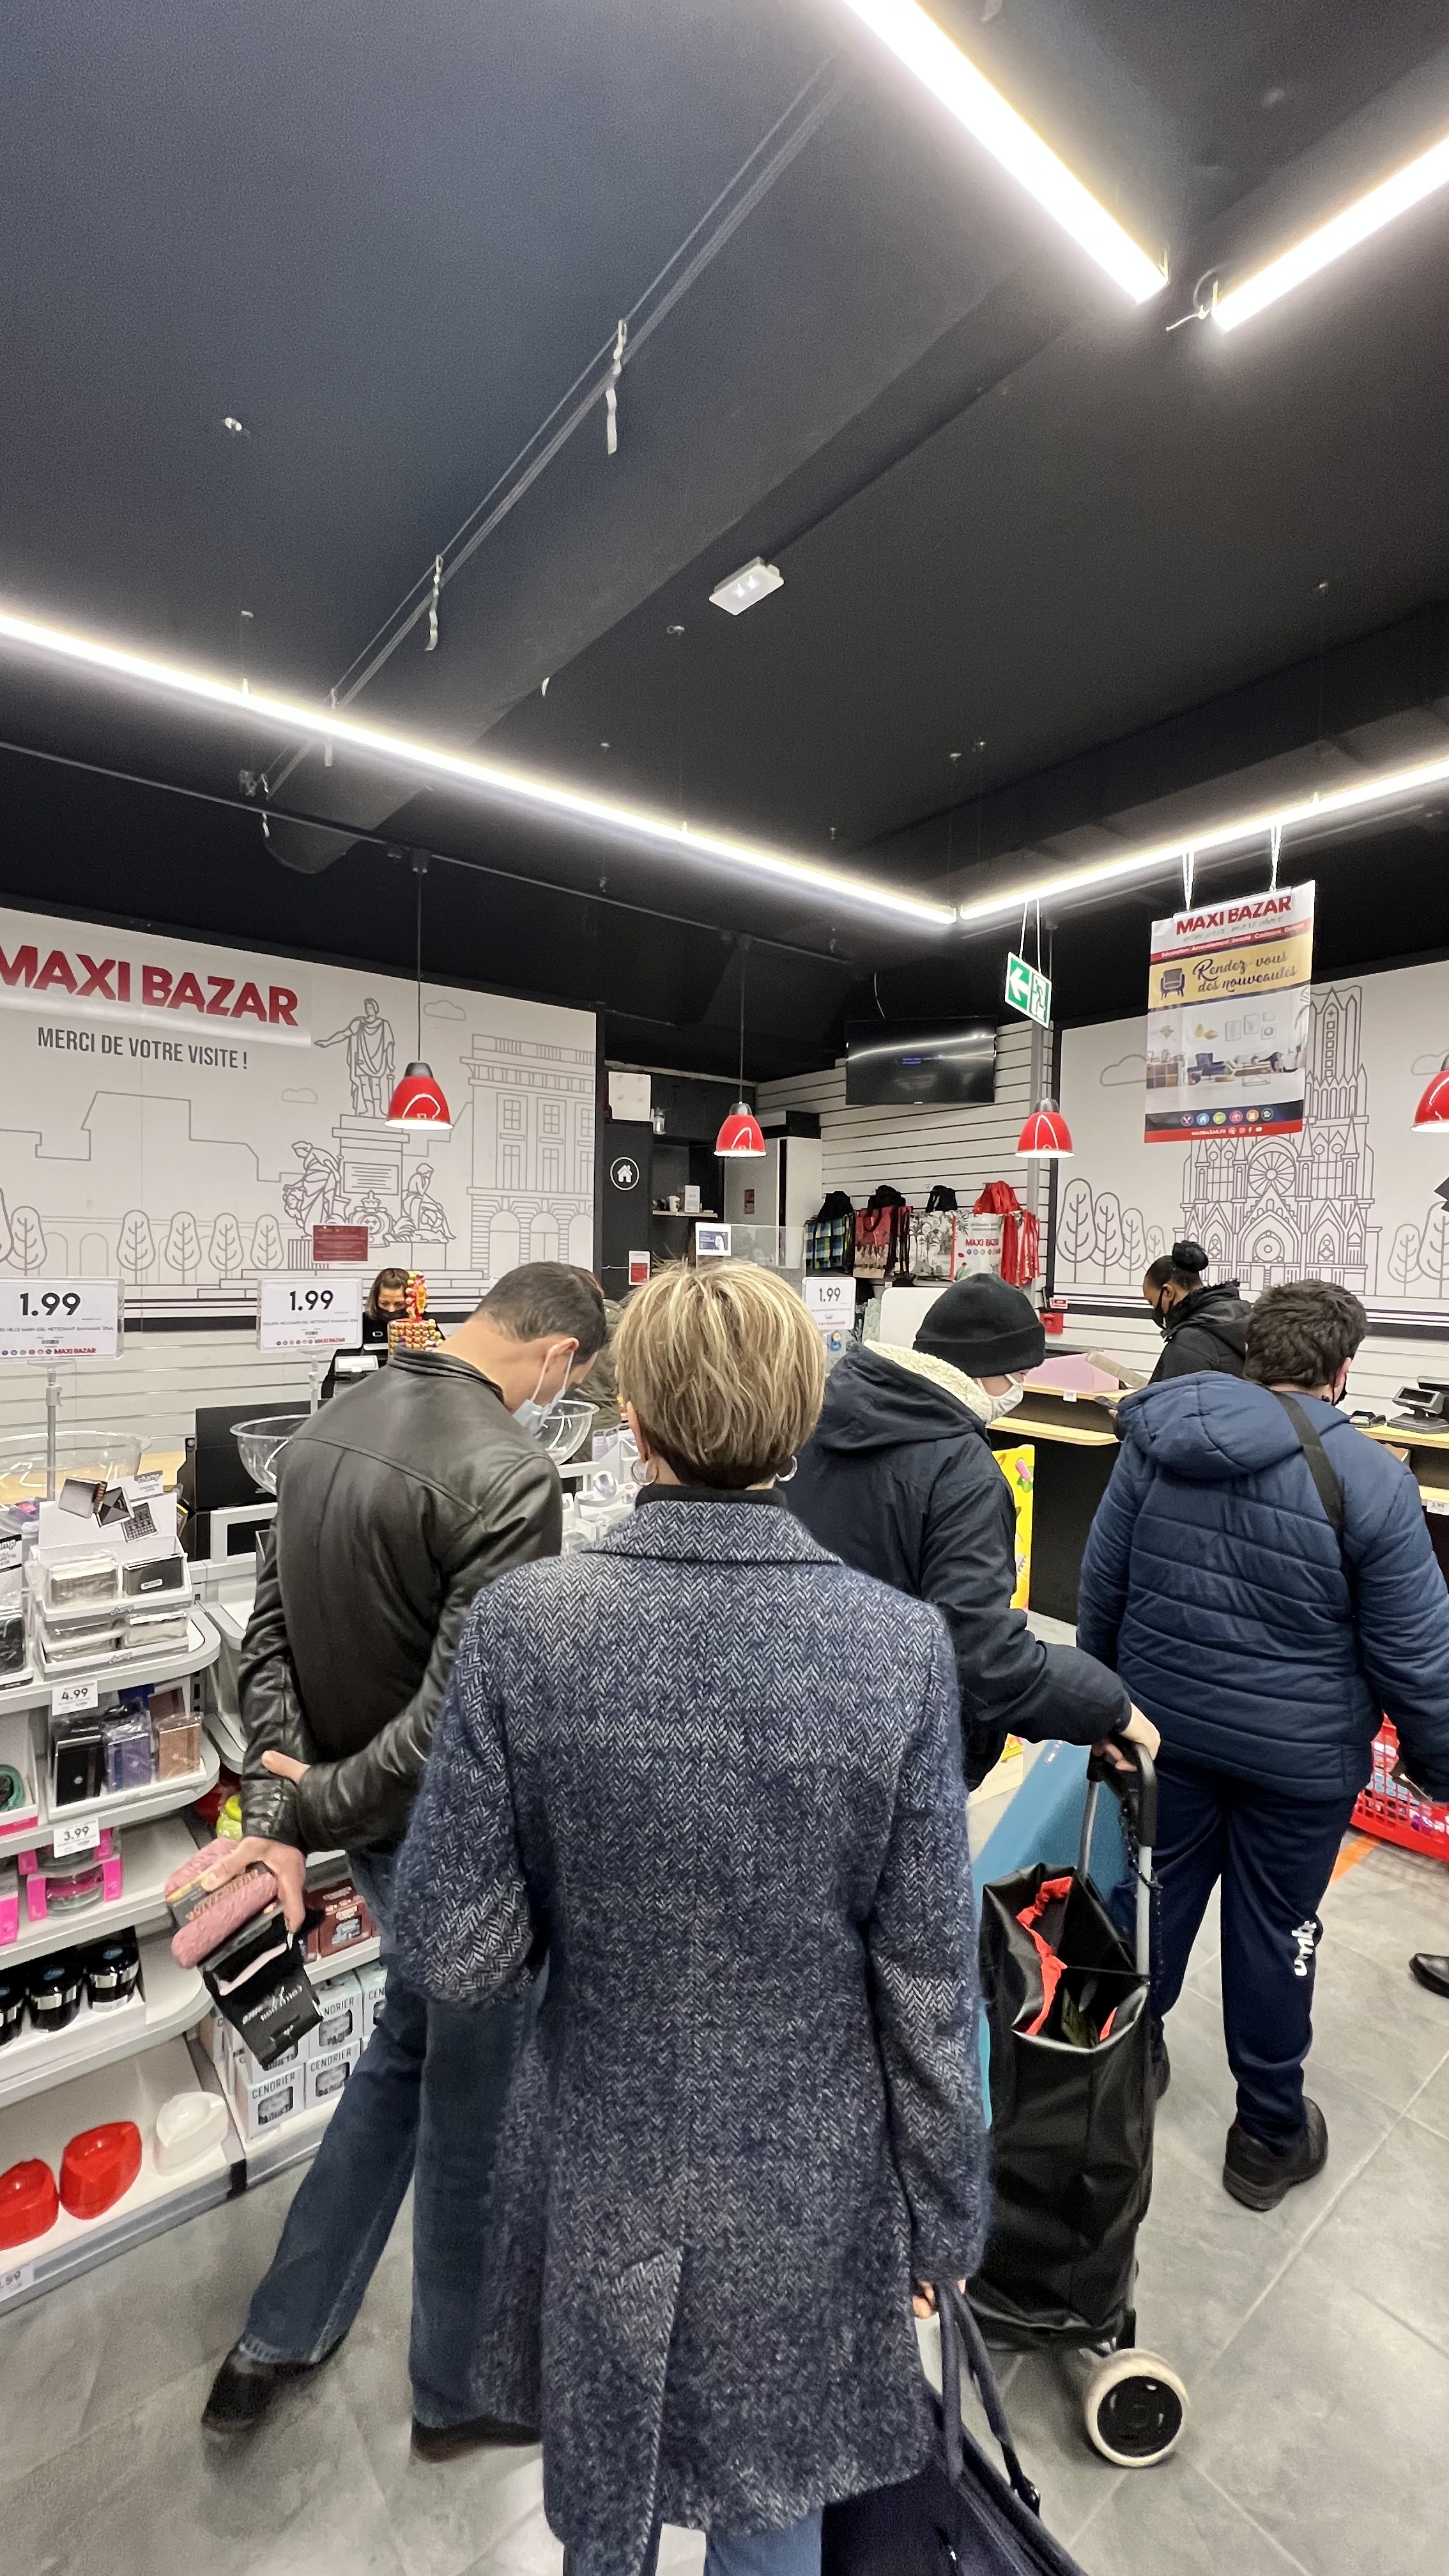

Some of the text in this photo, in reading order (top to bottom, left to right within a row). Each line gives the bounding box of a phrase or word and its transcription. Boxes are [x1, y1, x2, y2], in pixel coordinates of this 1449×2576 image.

[1176, 911, 1224, 935] MAXI
[1228, 896, 1292, 923] BAZAR
[0, 945, 298, 1026] MAXI BAZAR
[1198, 980, 1220, 992] des
[38, 1027, 95, 1052] MERCI
[102, 1035, 123, 1056] DE
[128, 1038, 183, 1062] VOTRE
[188, 1045, 238, 1069] VISITE
[20, 1292, 81, 1316] 1.99
[289, 1290, 334, 1311] 1.99
[819, 1287, 841, 1302] 1.99
[61, 1687, 88, 1701] 4.99
[64, 1826, 89, 1841] 3.99
[310, 2047, 351, 2072] CENDRIER
[252, 2071, 296, 2099] CENDRIER
